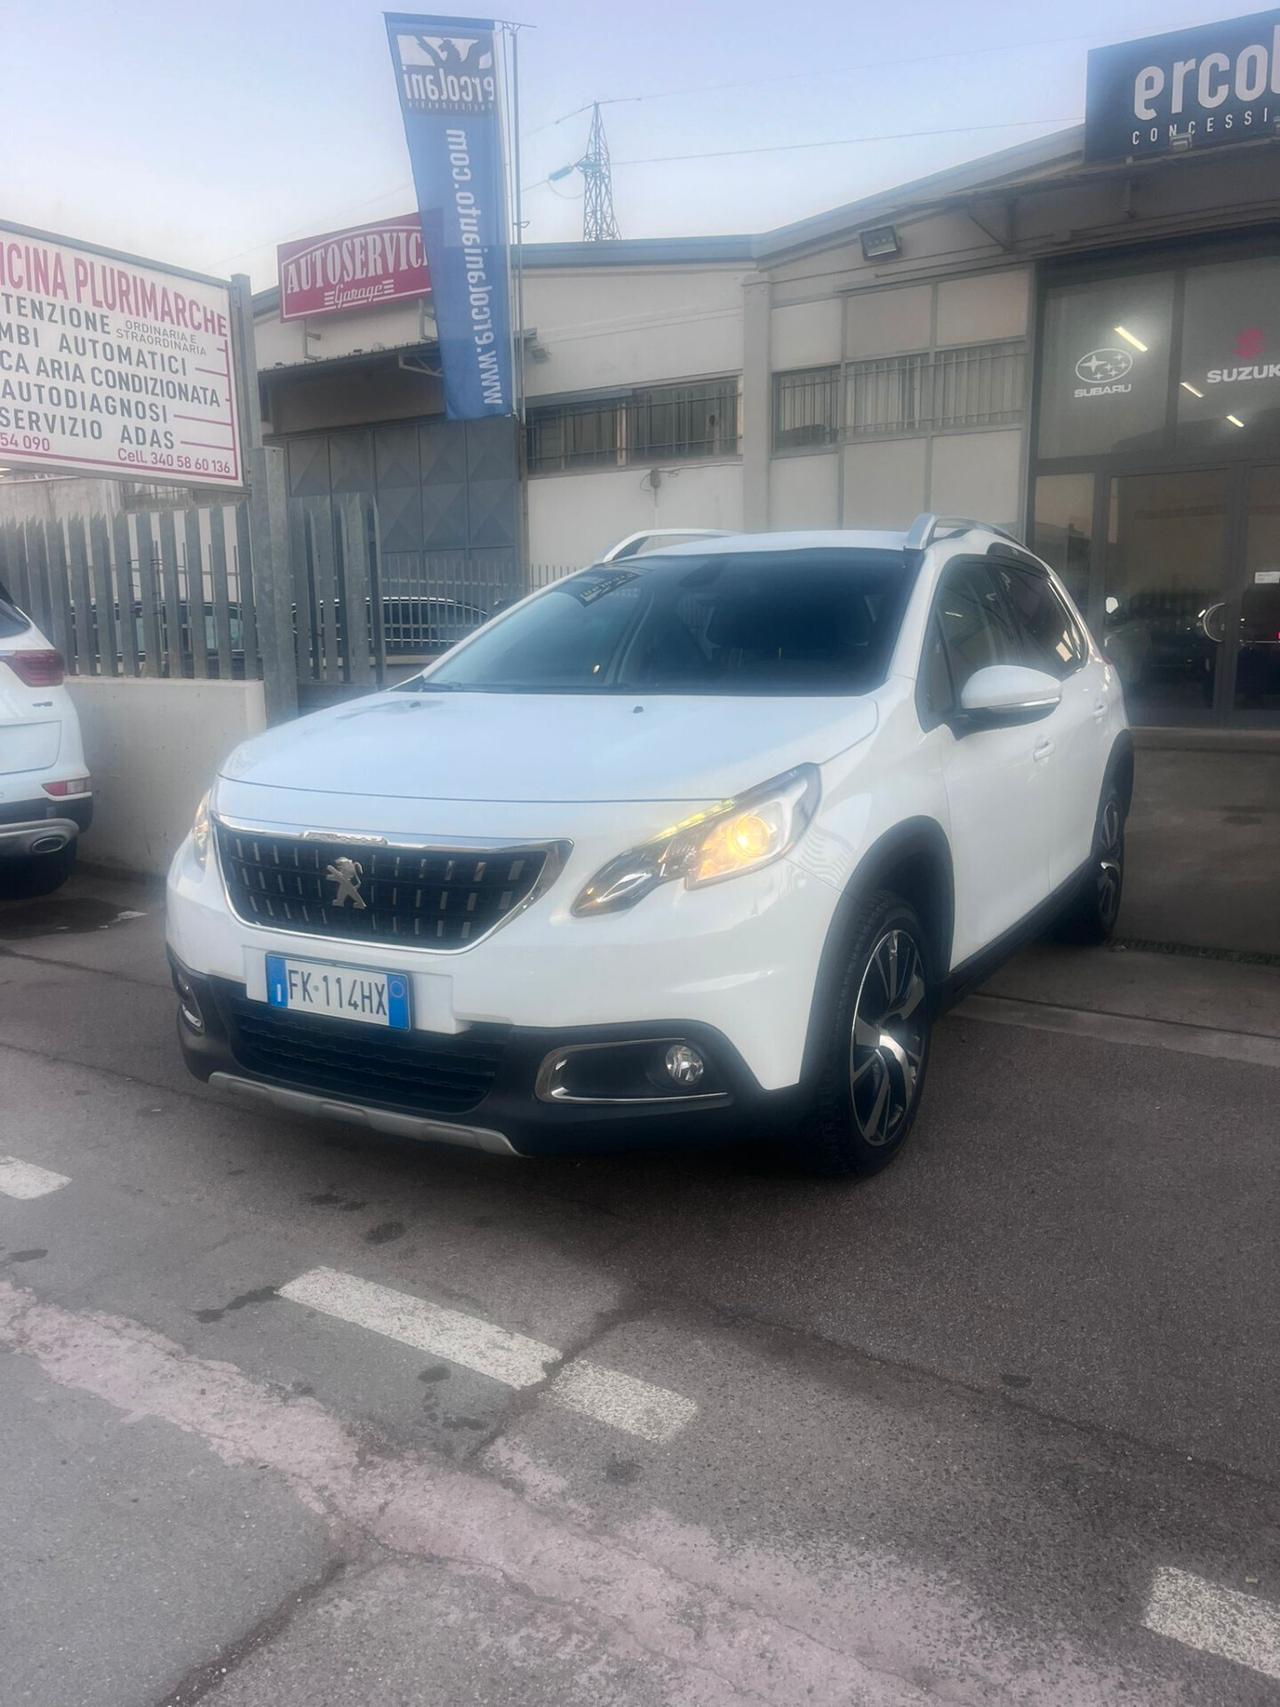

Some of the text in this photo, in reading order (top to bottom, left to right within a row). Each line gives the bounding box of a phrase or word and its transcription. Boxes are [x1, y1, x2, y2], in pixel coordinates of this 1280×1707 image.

[1134, 24, 1280, 120] ercol
[1132, 107, 1268, 145] CONCESSI
[287, 232, 428, 294] AUTOSERVIC
[1, 292, 111, 335] TENZIONE
[125, 320, 188, 343] ORDINARIA
[74, 257, 228, 338] PLURIMARCHE
[334, 283, 384, 309] Garage
[59, 333, 187, 377] AUTOMATICI
[116, 328, 207, 356] STRAORDINARIA
[1, 379, 168, 424] AUTODIAGNOSI
[36, 356, 86, 384] ARIA
[91, 366, 221, 408] CONDIZIONATA
[1074, 384, 1132, 398] SUBARU
[0, 406, 175, 450] SERVIZIO ADAS
[23, 435, 50, 451] 090
[118, 448, 230, 474] Cell. 340 58 60 136
